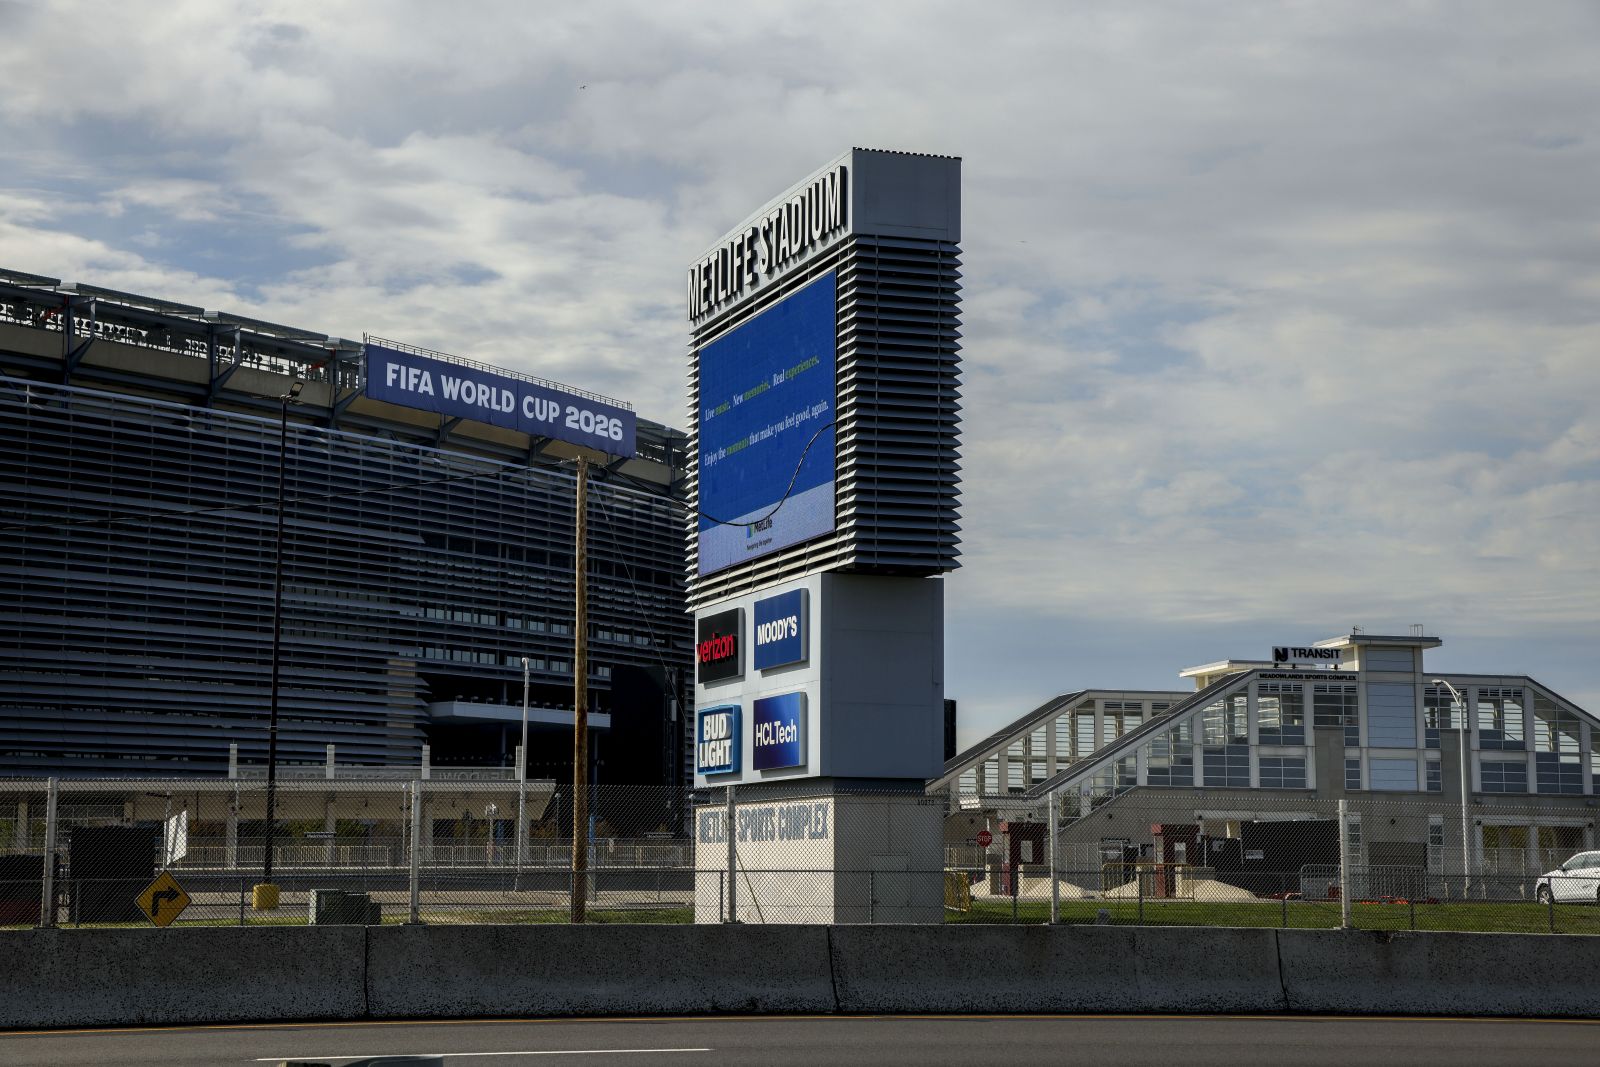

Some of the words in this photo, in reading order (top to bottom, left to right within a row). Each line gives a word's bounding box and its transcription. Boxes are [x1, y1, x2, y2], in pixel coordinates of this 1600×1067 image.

[688, 227, 757, 322] METLIFE
[759, 165, 846, 274] STADIUM
[386, 362, 434, 396] FIFA
[441, 374, 515, 413] WORLD
[522, 395, 560, 423] CUP
[565, 405, 623, 441] 2026
[705, 409, 714, 421] Live
[733, 393, 743, 407] New
[773, 369, 784, 386] Real
[705, 452, 717, 466] Enjoy
[718, 447, 726, 460] the
[750, 432, 759, 445] that
[760, 424, 774, 440] make
[775, 421, 784, 437] you
[785, 412, 795, 428] feel
[757, 615, 797, 645] MOODY'S
[696, 632, 734, 663] verizon
[1275, 647, 1288, 662] NJ
[1291, 648, 1341, 659] TRANSIT
[703, 713, 727, 741] BUD
[755, 719, 797, 747] HCLTech
[699, 739, 732, 768] LIGHT
[740, 808, 775, 842] SPORTS
[779, 803, 828, 840] COMPLEX
[977, 835, 992, 843] STOP
